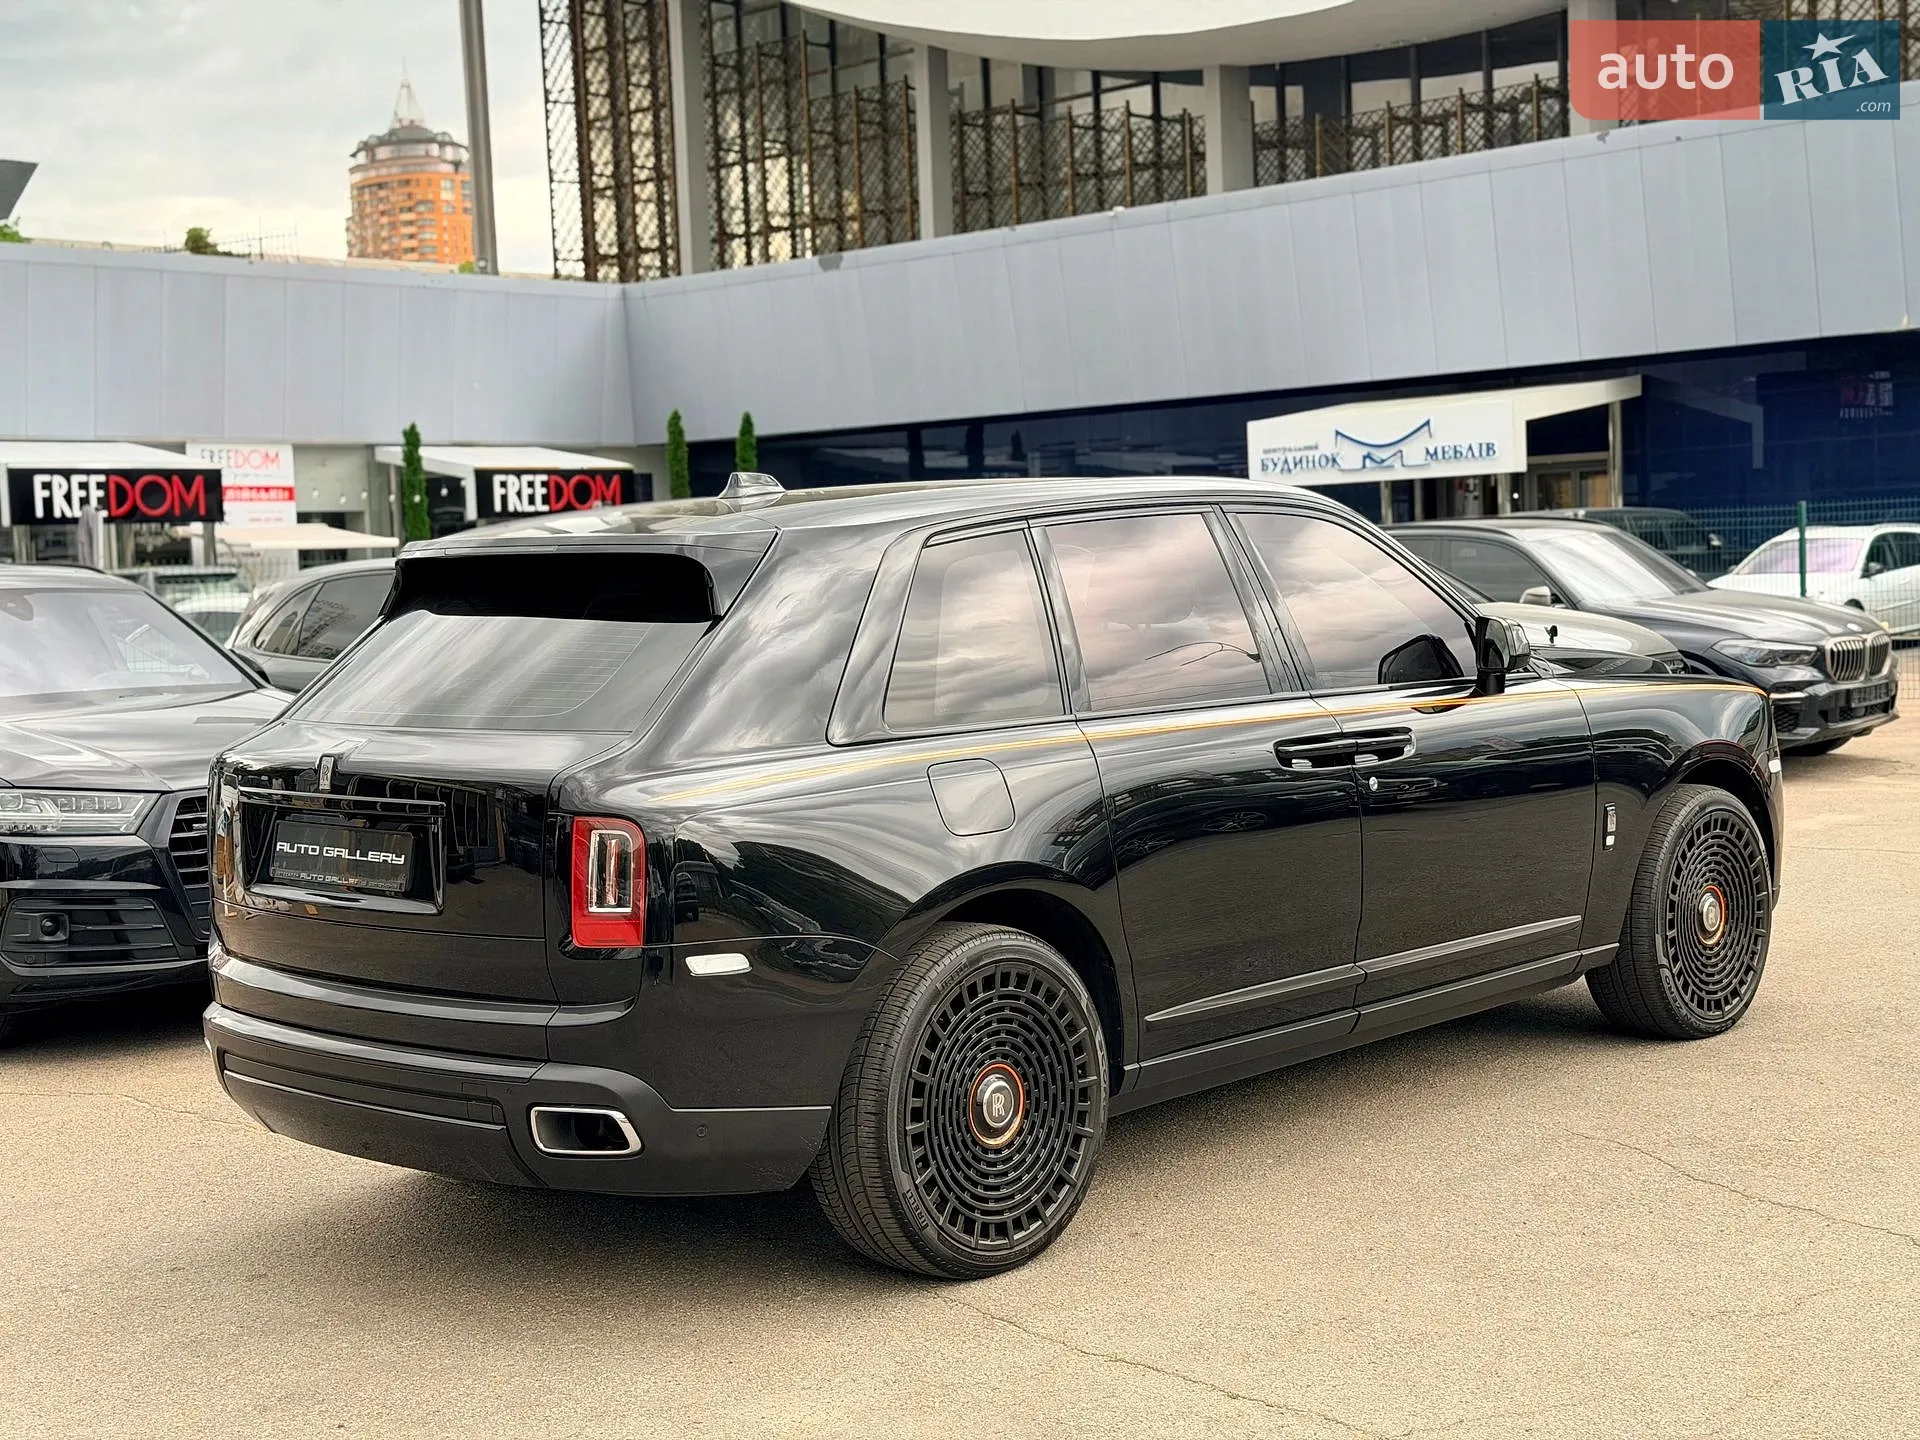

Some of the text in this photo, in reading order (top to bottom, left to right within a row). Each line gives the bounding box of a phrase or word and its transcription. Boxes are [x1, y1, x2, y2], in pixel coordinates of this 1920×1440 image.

[1260, 442, 1496, 475] БУДИНОК МЕБЛІВ
[33, 474, 207, 519] FREEDOM
[492, 474, 622, 513] FREEDOM
[276, 841, 406, 865] AUTO GALLERY
[902, 1188, 929, 1231] PIRELLI
